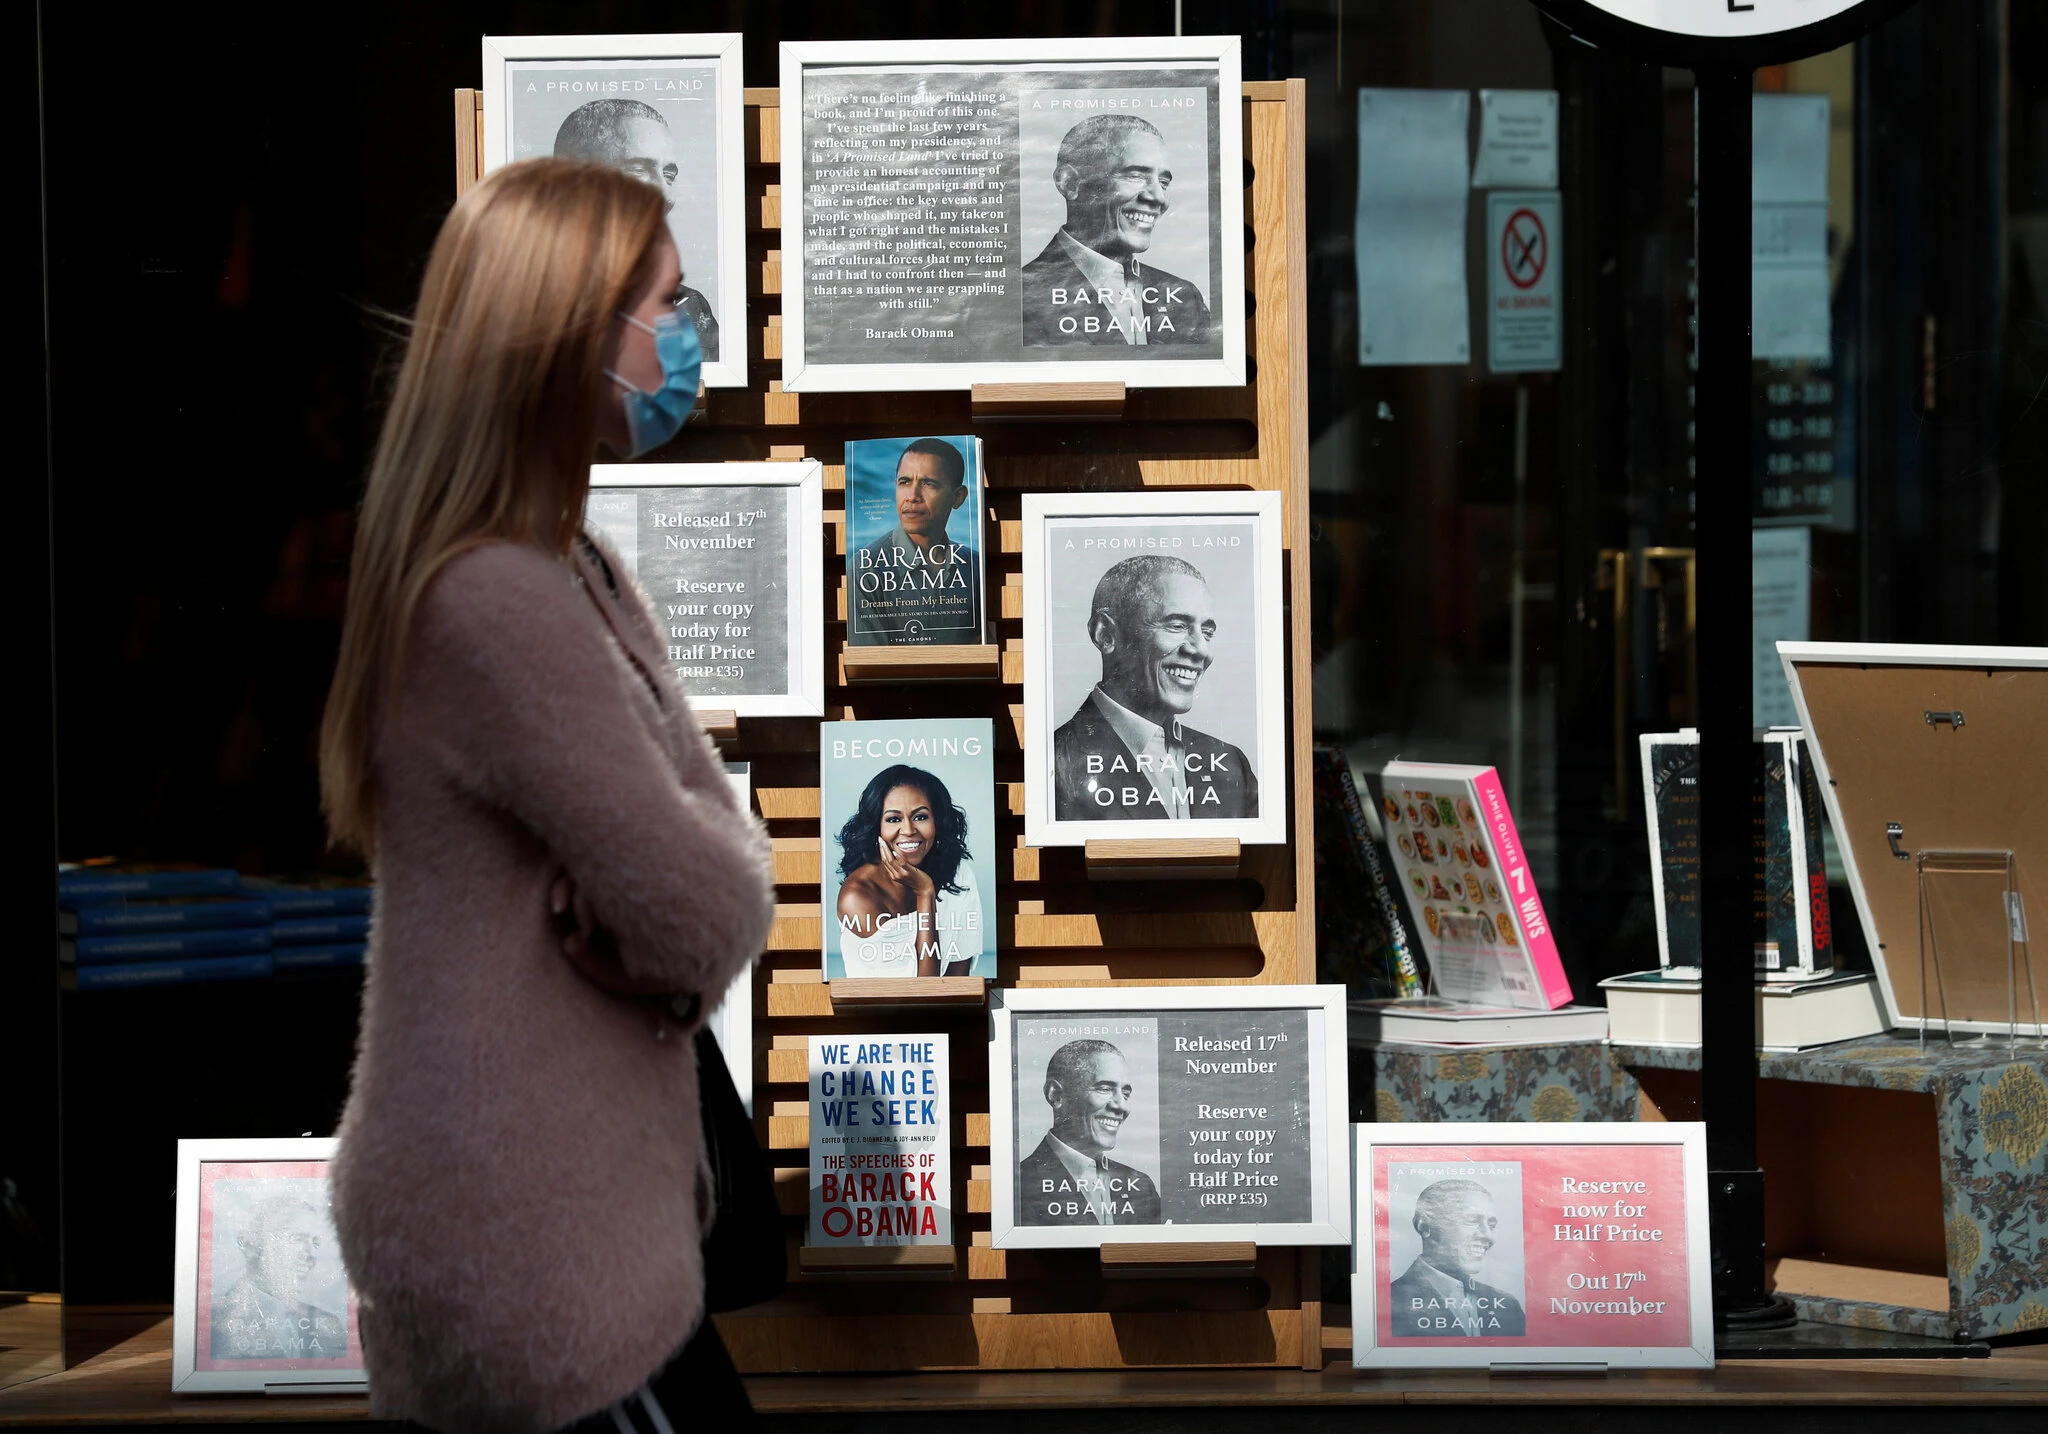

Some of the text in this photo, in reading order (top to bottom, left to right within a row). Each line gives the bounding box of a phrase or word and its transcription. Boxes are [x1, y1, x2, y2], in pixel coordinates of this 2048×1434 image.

[527, 80, 703, 92] A PROMISED LAND
[1032, 97, 1196, 109] A PROMISED LAND
[814, 107, 1000, 119] book, and I'm proud of this one.
[828, 122, 987, 134] I've spent the last few years
[814, 136, 1001, 149] reflecting on my presidency, and
[816, 165, 1001, 179] provide an honest accounting of
[810, 180, 1006, 193] my presidential campaign and my
[808, 224, 1008, 238] what I got right and the mistakes I
[814, 286, 837, 295] that
[866, 285, 902, 294] nation
[948, 283, 1005, 295] grappling
[1052, 286, 1183, 305] BARACK
[879, 299, 905, 309] with
[866, 328, 954, 339] Barack Obama
[1059, 316, 1176, 334] OBAMA
[594, 502, 629, 511] LAND
[654, 509, 767, 527] Released 17th
[665, 535, 756, 551] November
[1065, 536, 1241, 549] A PROMISED LAND
[860, 544, 967, 570] BARACK
[676, 579, 745, 593] Reserve
[860, 568, 967, 592] OBAMA
[861, 595, 968, 608] Dreams From My Father
[667, 602, 753, 619] your copy
[671, 622, 751, 640] today for
[668, 644, 756, 661] Half Price
[677, 664, 744, 680] (RRP £35)
[833, 737, 982, 759] BECOMING
[1087, 753, 1229, 775] BARACK
[1095, 786, 1221, 806] OBAMA
[1486, 789, 1517, 864] JAMIE OLIVER
[1341, 771, 1415, 976] GUINNESS WORLD RECORDS 2021
[1510, 866, 1546, 939] 7 WAYS
[1810, 874, 1826, 950] BLOOD
[840, 911, 978, 932] MICHELLE
[858, 942, 962, 962] OBAMA
[1041, 1026, 1109, 1035] PROMISED
[1115, 1026, 1149, 1034] LAND
[1174, 1033, 1288, 1052] Released 17th
[822, 1043, 934, 1064] WE ARE THE
[1186, 1059, 1277, 1074] November
[822, 1070, 934, 1096] CHANGE
[822, 1100, 936, 1126] WE SEEK
[1198, 1104, 1267, 1119] Reserve
[1190, 1127, 1276, 1145] your copy
[822, 1154, 935, 1169] THE SPEECHES OF
[1194, 1149, 1273, 1167] today for
[1189, 1171, 1278, 1188] Half Price
[1410, 1168, 1474, 1176] PROMISED
[822, 1172, 936, 1203] BARACK
[1042, 1178, 1140, 1193] BARACK
[1561, 1178, 1646, 1194] Reserve
[1048, 1201, 1134, 1215] OBAMA
[1200, 1193, 1267, 1207] (RRP £35)
[1563, 1201, 1646, 1218] now for
[822, 1206, 937, 1237] OBAMA
[1554, 1224, 1662, 1242] Half Price
[1567, 1271, 1646, 1290] Out 17th
[1412, 1297, 1506, 1309] BARACK
[1550, 1297, 1666, 1316] November
[1418, 1317, 1501, 1329] OBAMA
[236, 1338, 323, 1351] OBAMA
